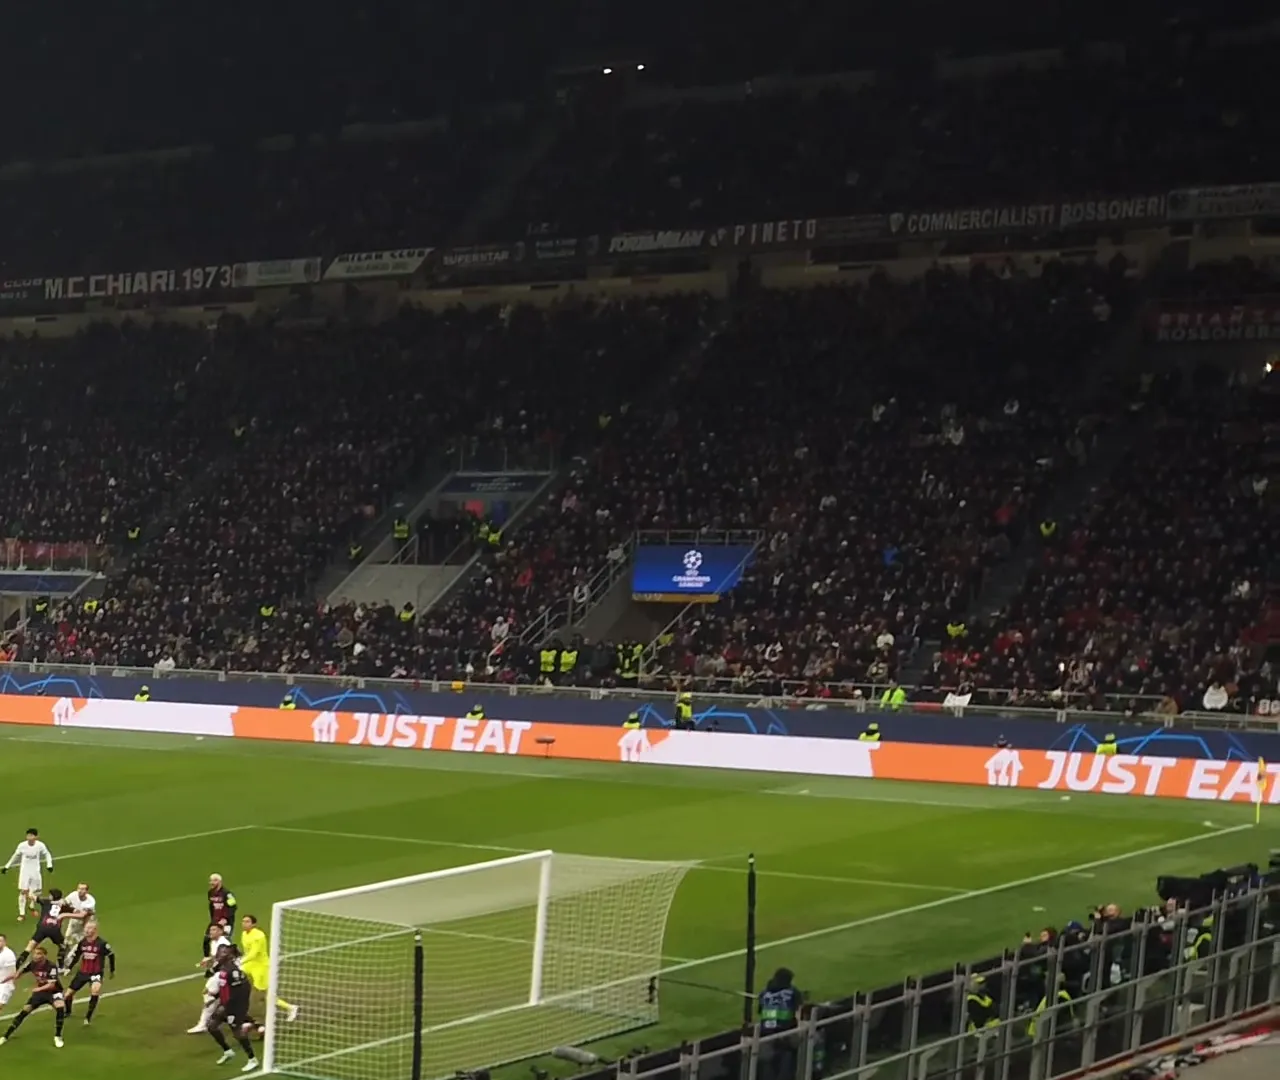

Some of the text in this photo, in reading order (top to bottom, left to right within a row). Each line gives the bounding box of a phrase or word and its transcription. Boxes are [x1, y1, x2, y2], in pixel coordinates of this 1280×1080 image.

[734, 219, 817, 246] PINETO
[908, 204, 1054, 233] COMMERCIALISTI
[1060, 194, 1166, 227] ROSSONERI
[443, 250, 510, 266] SUPERSTAR
[349, 712, 532, 755] JUST EAT
[1038, 749, 1177, 796] JUST
